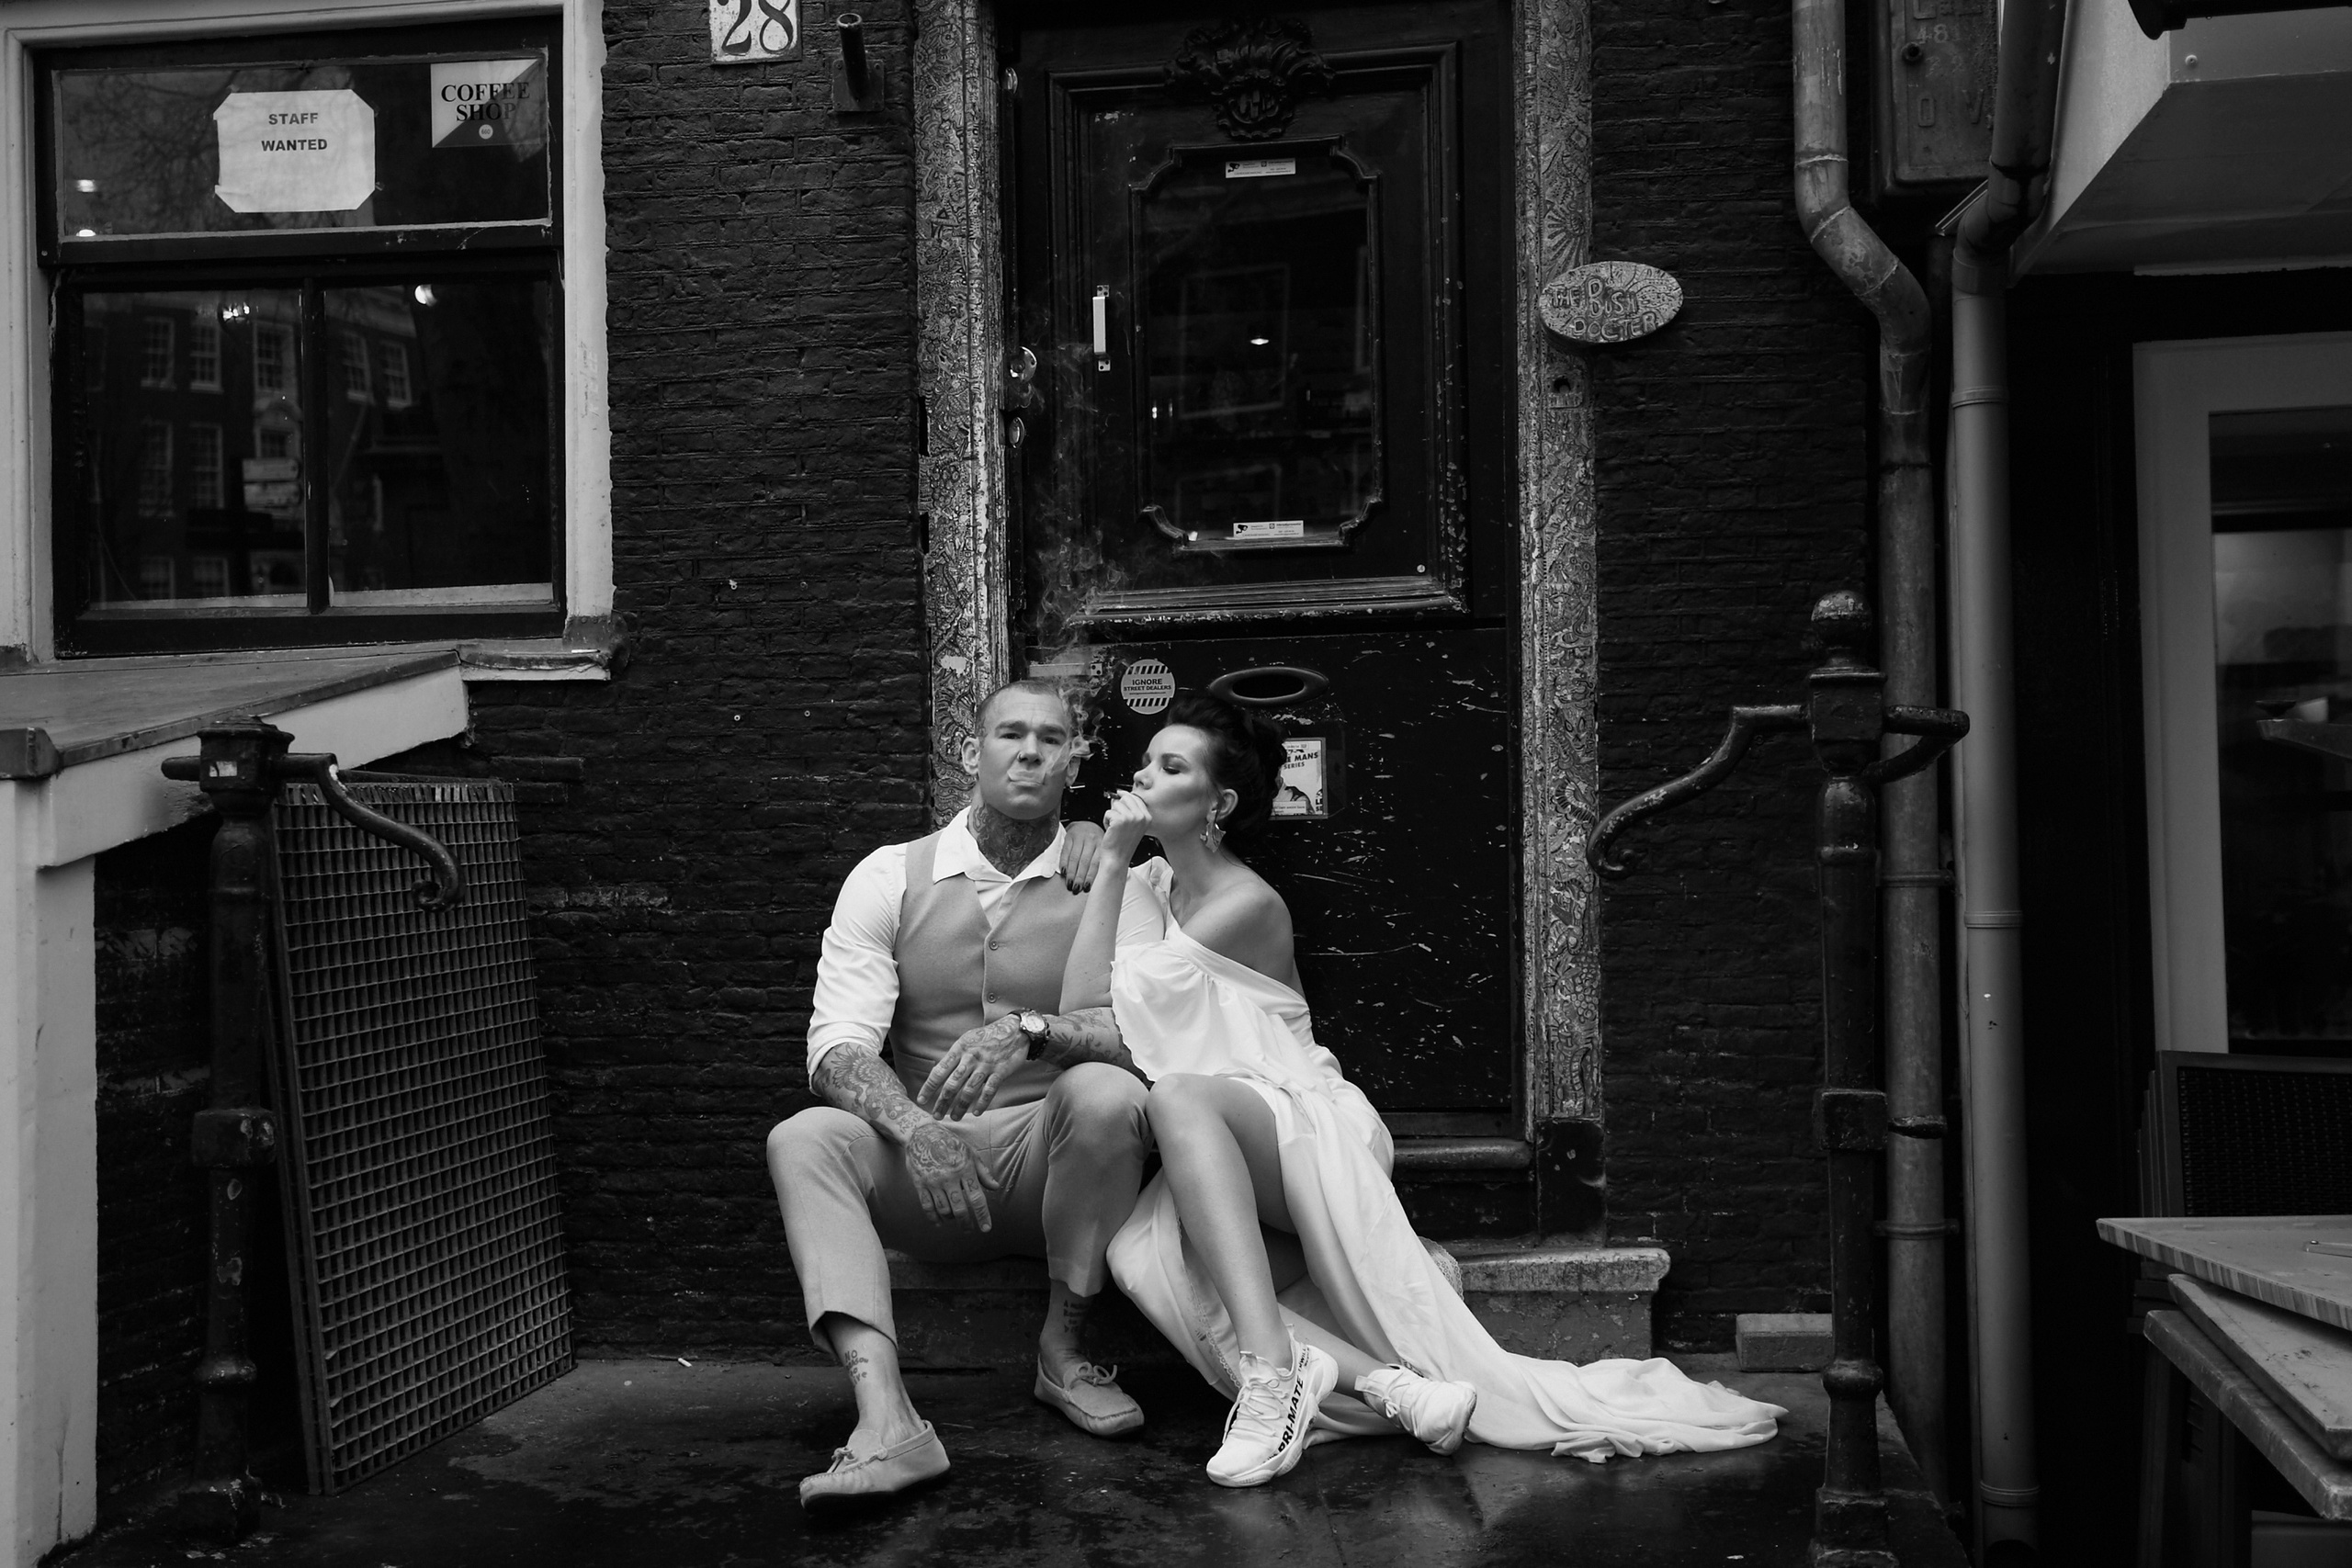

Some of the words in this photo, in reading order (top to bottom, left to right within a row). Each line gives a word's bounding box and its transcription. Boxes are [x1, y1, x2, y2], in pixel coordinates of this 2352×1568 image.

[718, 0, 794, 56] 28
[441, 82, 530, 102] COFFEE
[268, 112, 319, 125] STAFF
[456, 103, 515, 121] SHOP
[261, 139, 328, 152] WANTED
[1295, 751, 1318, 761] MANS
[1283, 761, 1305, 770] SERIES
